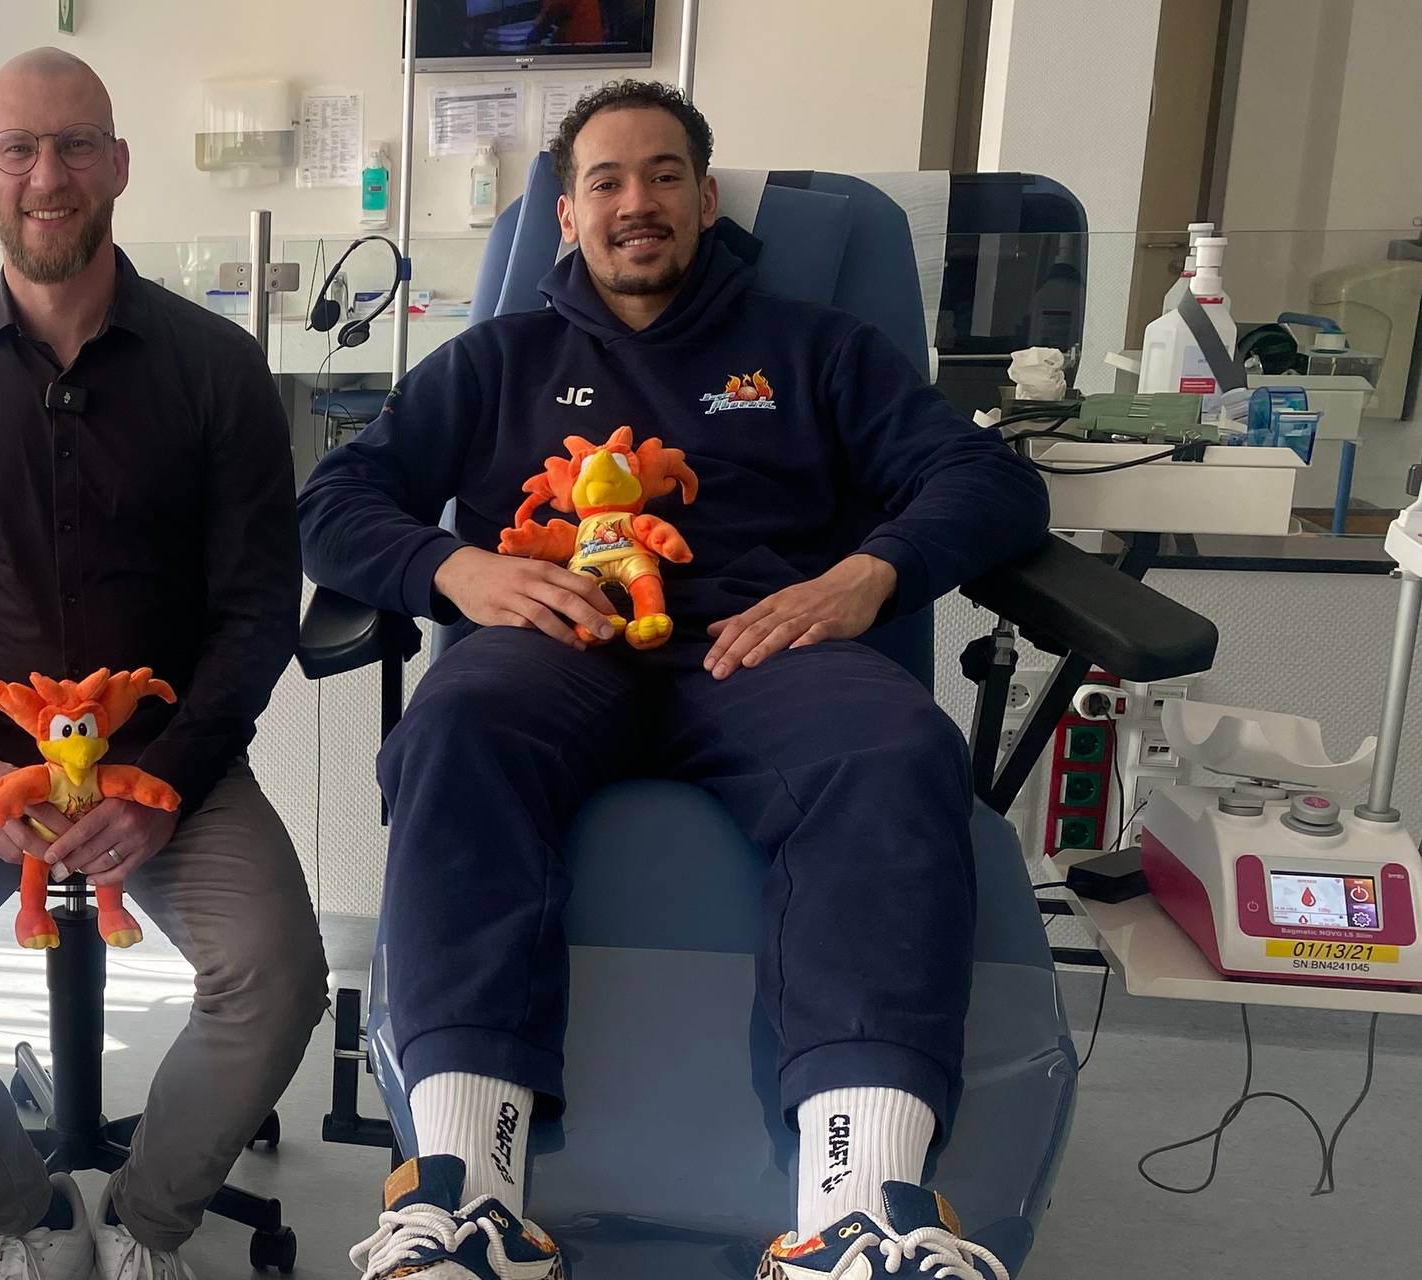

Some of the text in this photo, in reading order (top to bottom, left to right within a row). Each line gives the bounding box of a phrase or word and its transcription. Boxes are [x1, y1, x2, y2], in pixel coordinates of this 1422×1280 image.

[556, 387, 594, 406] JC
[1281, 927, 1318, 936] Bagmatic
[1293, 942, 1374, 960] 01/13/21
[1292, 959, 1370, 972] SN:BN4241045
[495, 1101, 520, 1168] CRAFT
[828, 1114, 850, 1168] CRAFT
